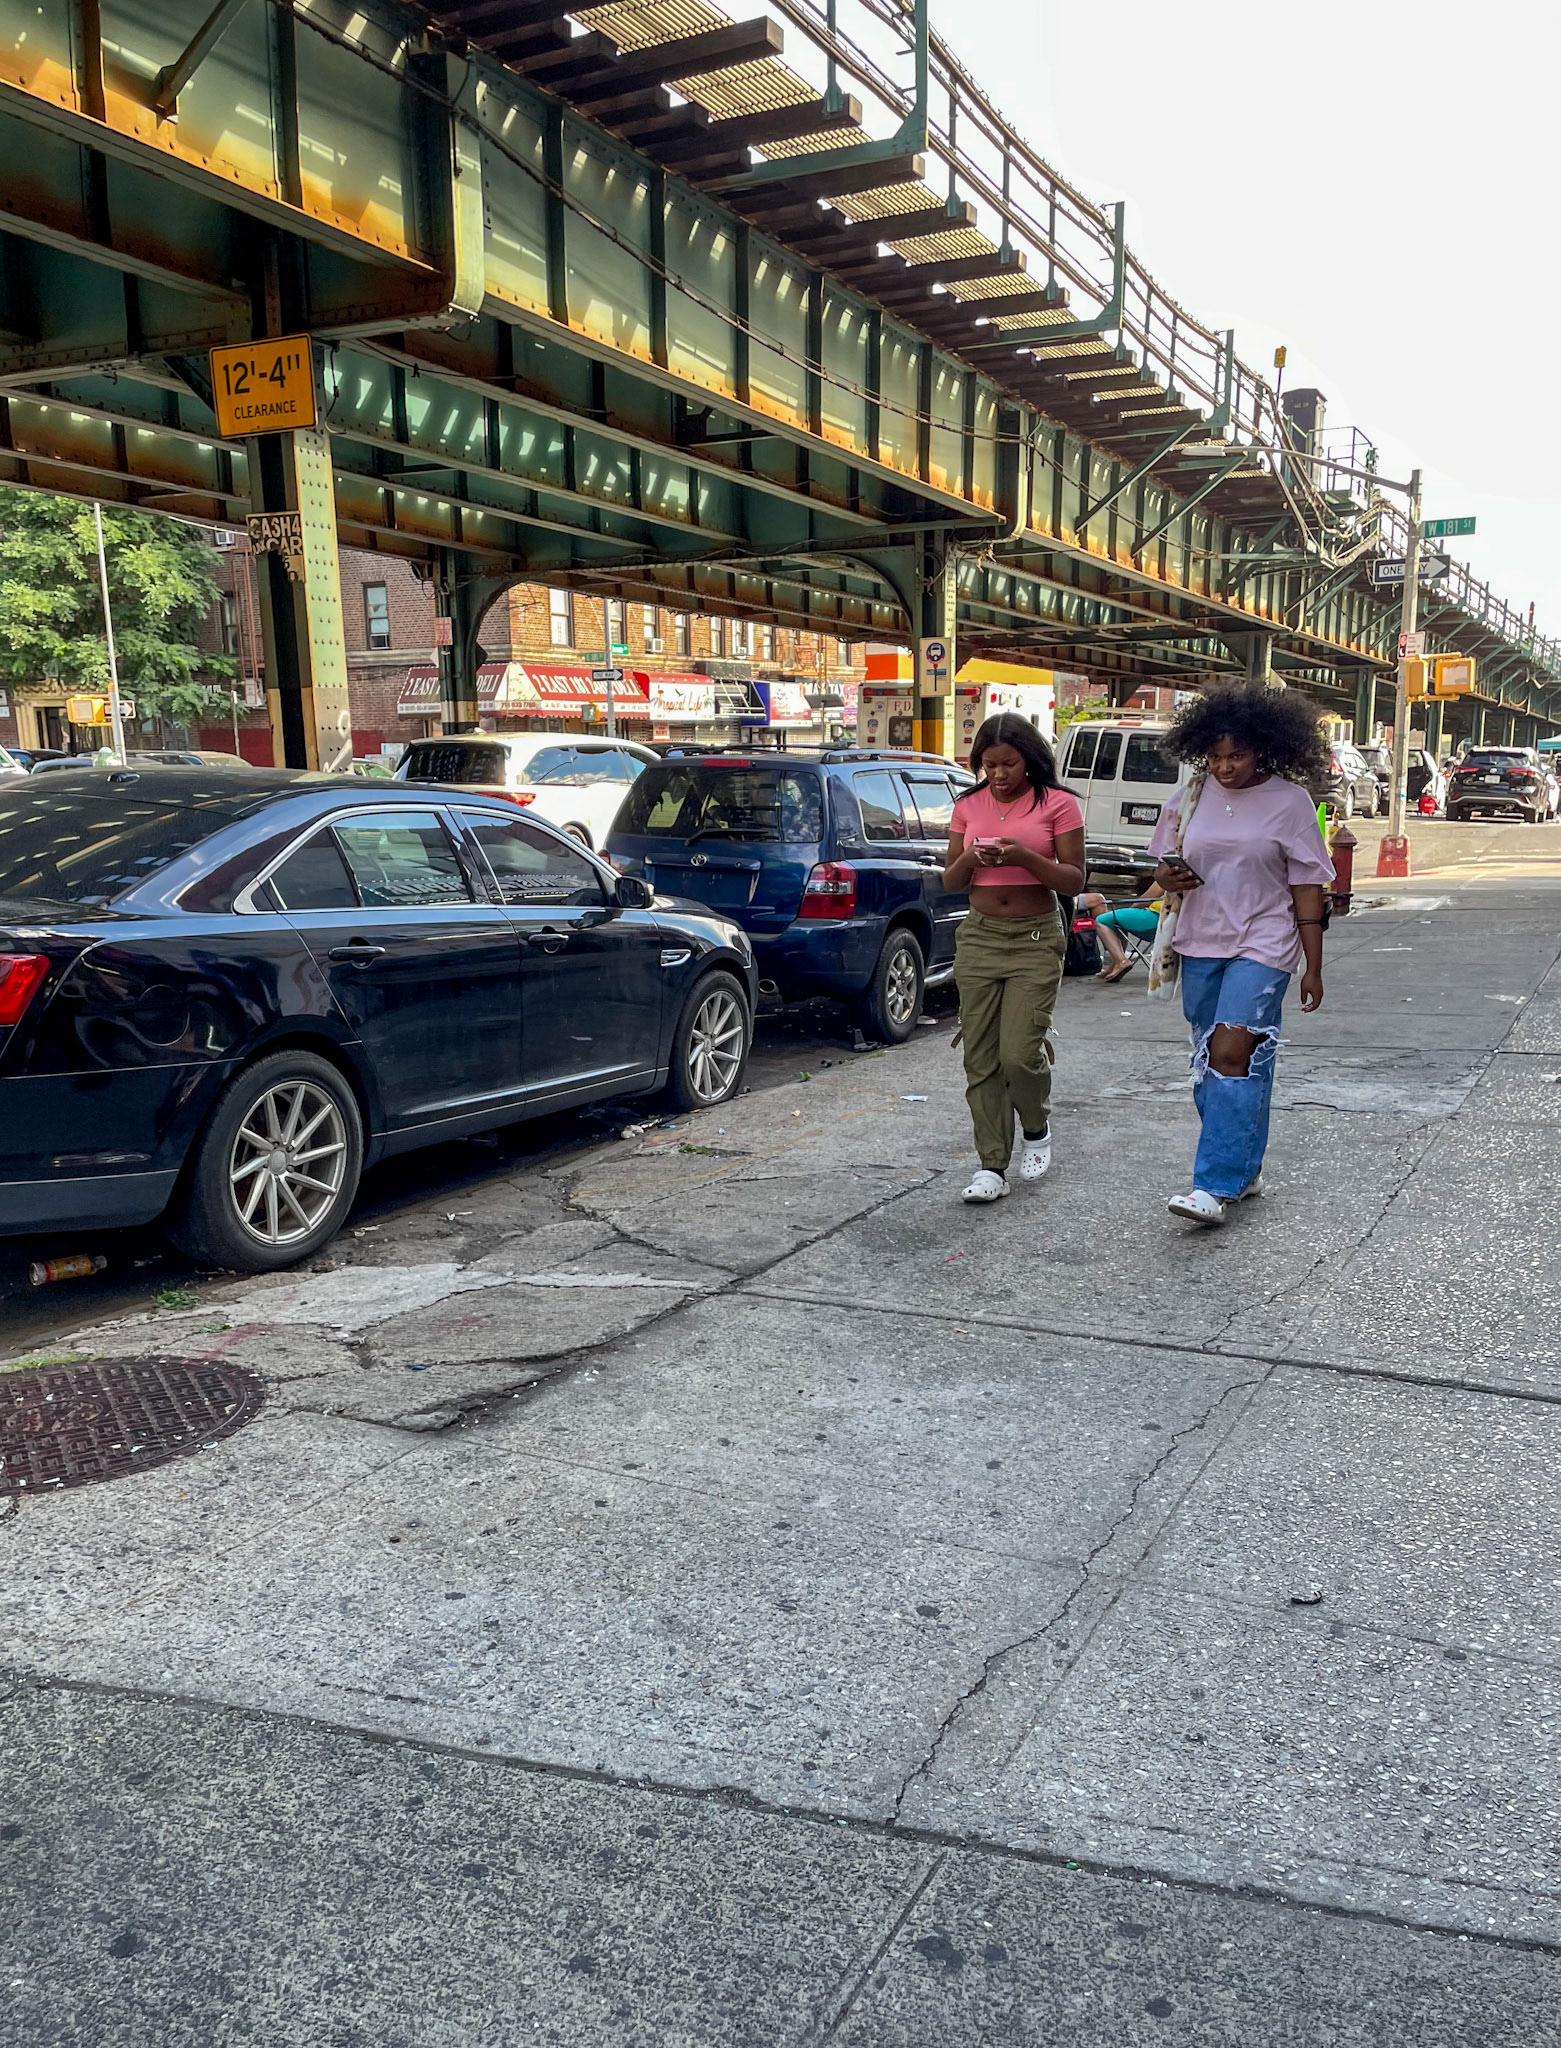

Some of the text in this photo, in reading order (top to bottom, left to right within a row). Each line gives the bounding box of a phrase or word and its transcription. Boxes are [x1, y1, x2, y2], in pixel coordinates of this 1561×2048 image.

[234, 400, 297, 420] CLEARANCE
[1428, 520, 1472, 536] W 181 St
[1382, 564, 1404, 576] ONE
[405, 677, 439, 696] 2 EAST
[476, 674, 500, 693] DELI
[532, 674, 546, 693] 2
[540, 675, 573, 694] EAST
[569, 676, 591, 694] 181
[963, 703, 977, 711] 206
